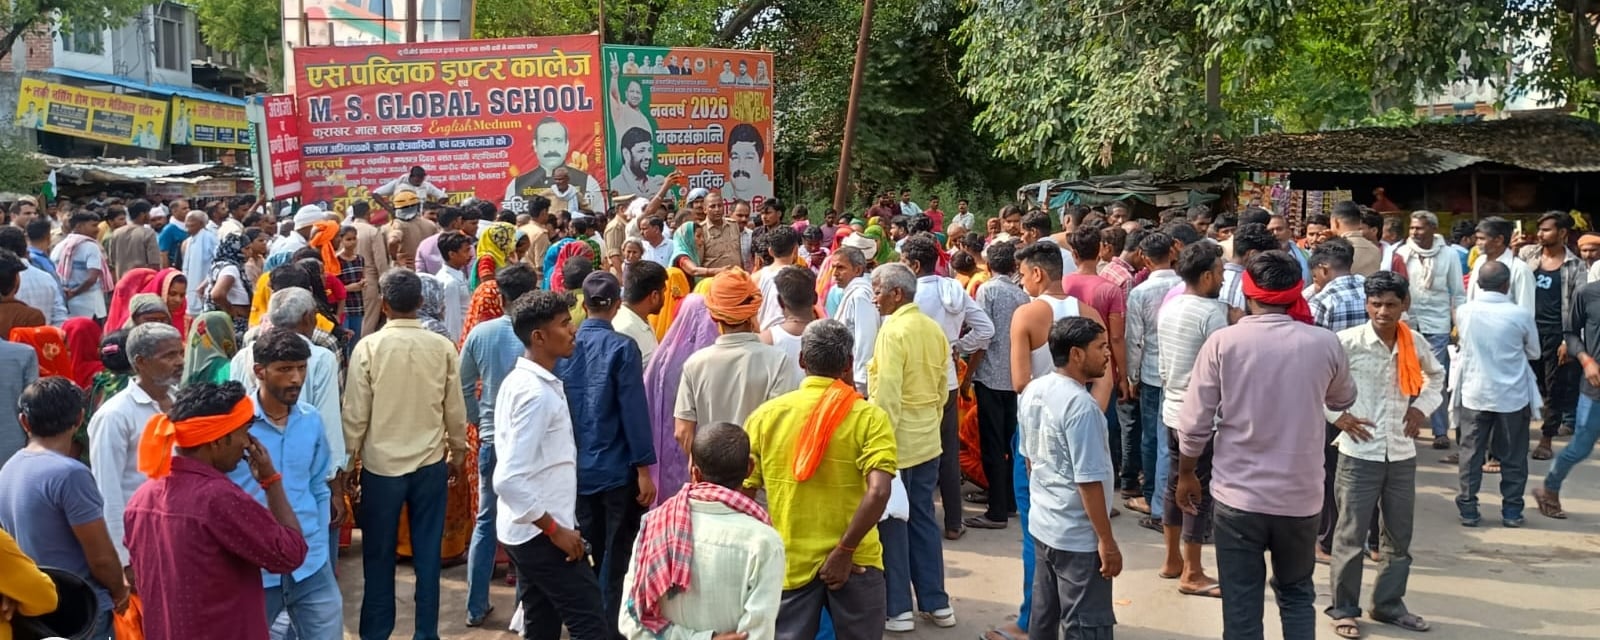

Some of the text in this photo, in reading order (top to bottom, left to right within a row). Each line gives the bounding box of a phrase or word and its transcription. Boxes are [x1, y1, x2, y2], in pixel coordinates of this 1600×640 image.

[441, 58, 507, 86] इण्टर
[511, 50, 592, 79] कालेज
[308, 84, 593, 123] M. S. GLOBAL SCHOOL
[650, 96, 728, 119] नववर्ष 2026
[428, 118, 523, 137] English Medium
[696, 148, 722, 163] दिवस
[1537, 275, 1552, 289] 23
